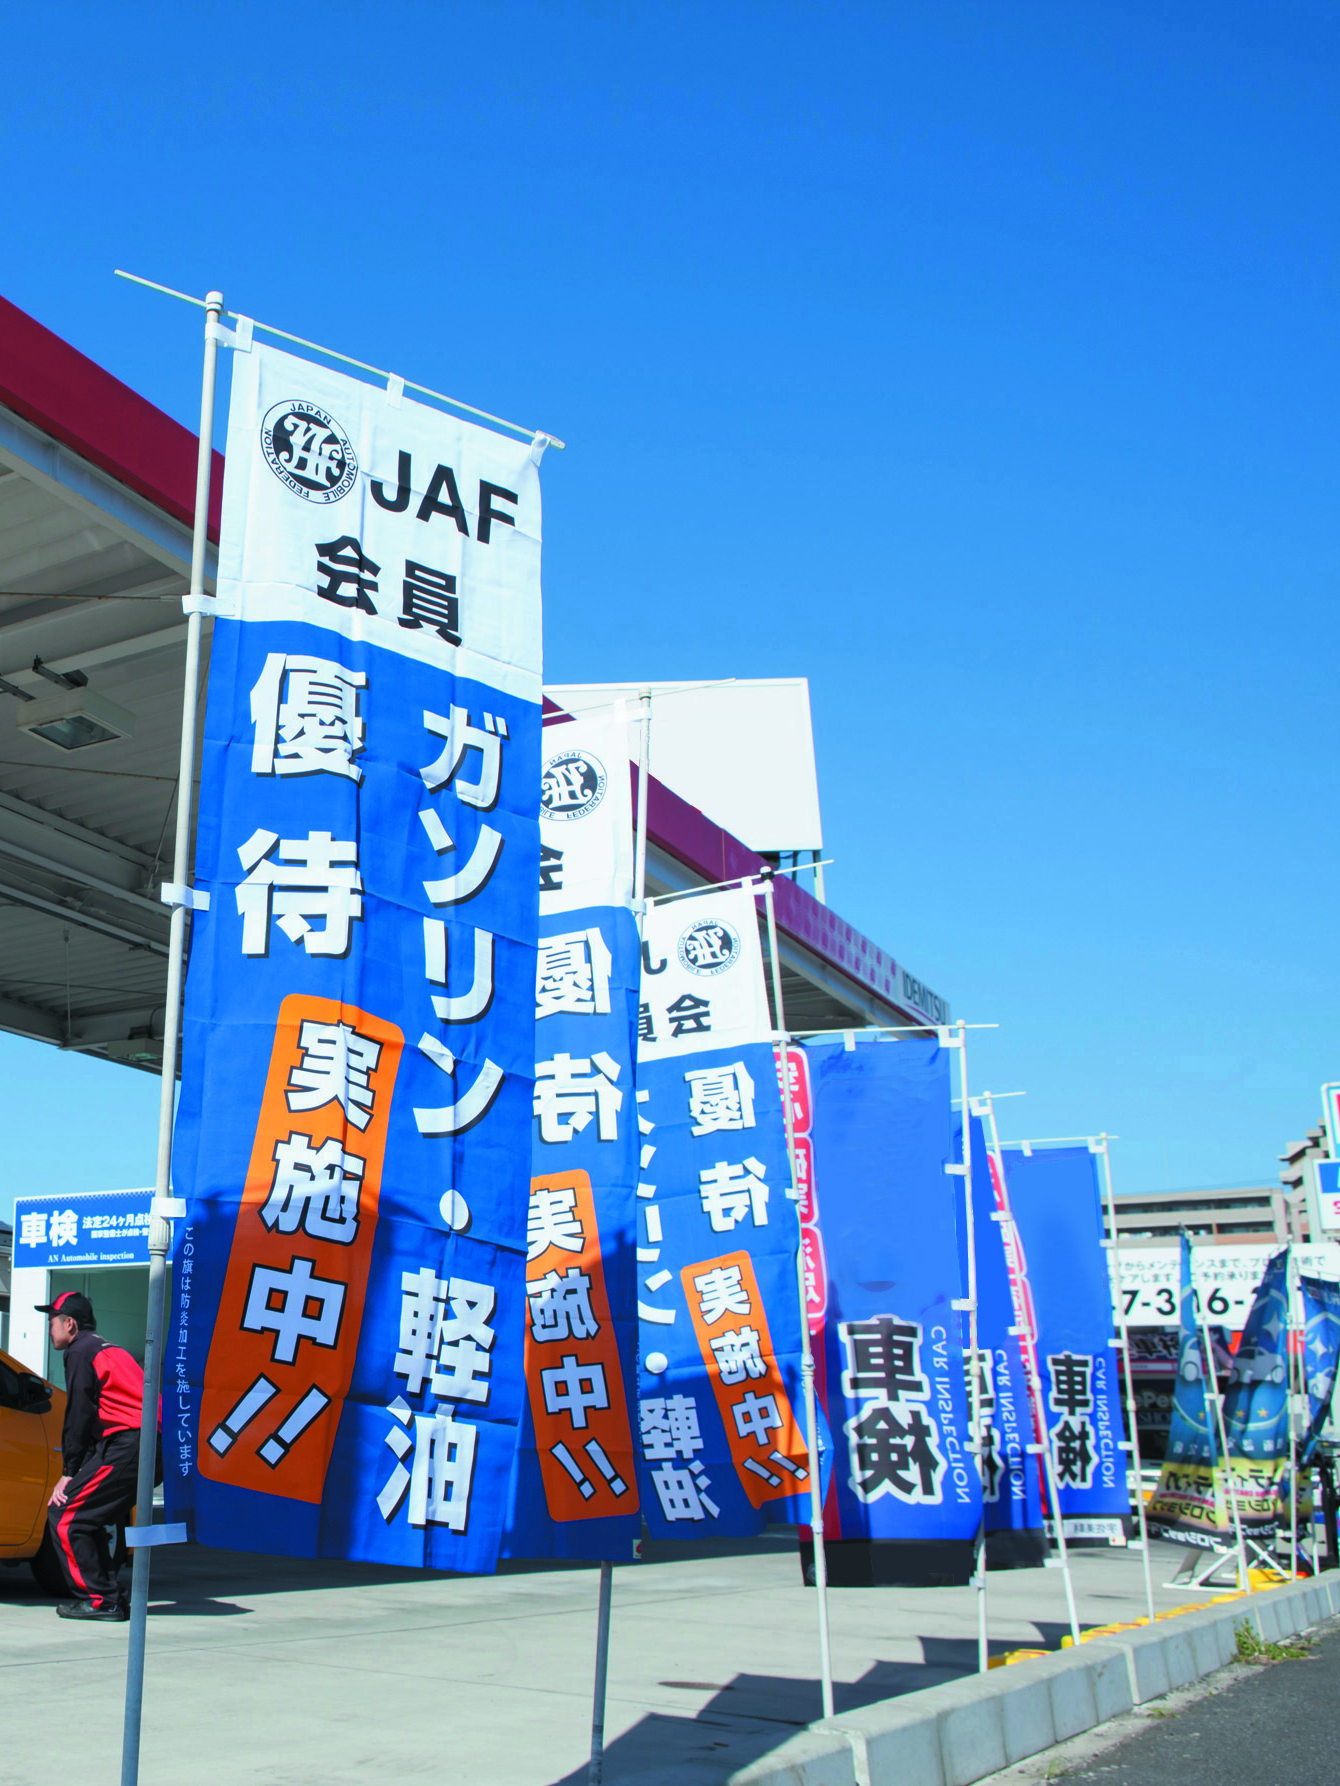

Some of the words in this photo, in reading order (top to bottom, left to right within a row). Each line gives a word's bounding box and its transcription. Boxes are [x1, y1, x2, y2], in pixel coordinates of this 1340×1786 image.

[290, 402, 332, 425] JAPAN
[263, 427, 310, 498] FEDERATION
[321, 438, 356, 501] AUTOMOBILE
[369, 450, 519, 544] JAF
[315, 535, 462, 647] 会員
[235, 652, 368, 957] 優待
[902, 970, 947, 1025] IDEMITSU
[377, 703, 509, 1531] ガソリン・軽油
[19, 1209, 79, 1248] 車検
[48, 1254, 59, 1263] AN
[60, 1252, 98, 1263] Automobile
[100, 1251, 134, 1262] inspection
[175, 1226, 194, 1477] この旗は防炎加工を施しています
